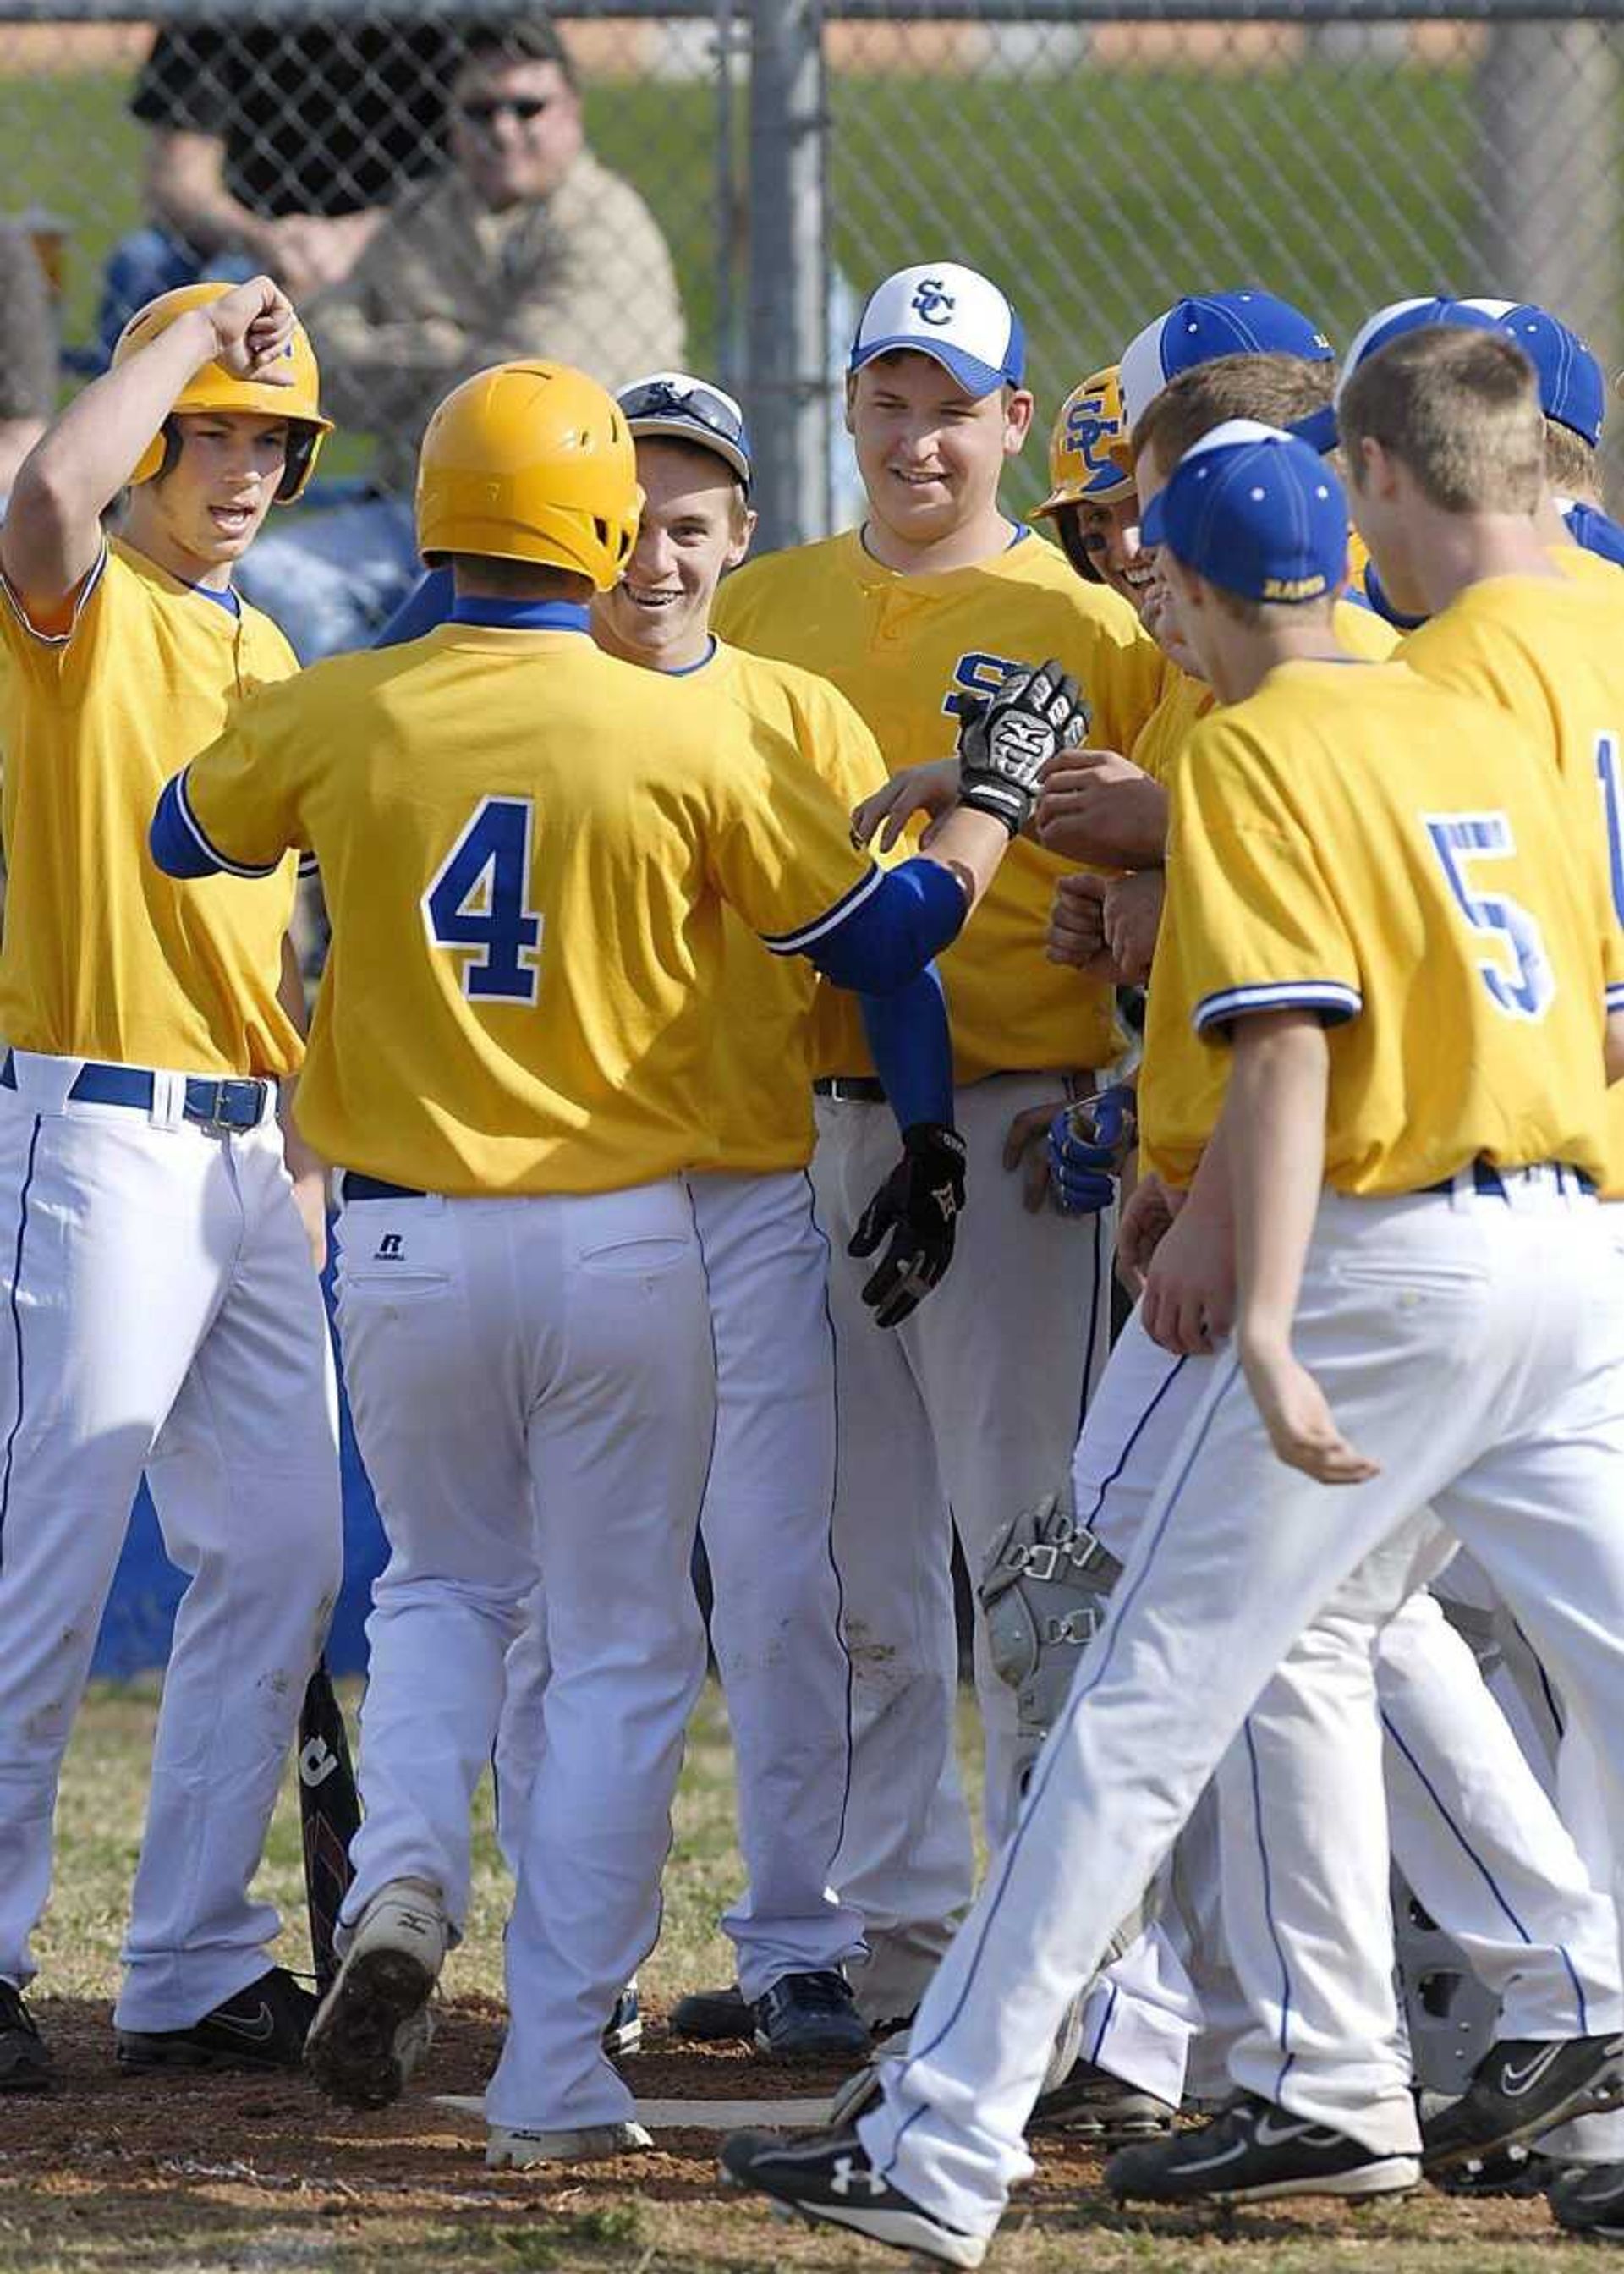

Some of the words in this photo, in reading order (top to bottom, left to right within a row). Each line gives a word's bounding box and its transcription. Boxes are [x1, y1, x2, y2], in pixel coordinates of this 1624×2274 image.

[911, 278, 955, 326] SC
[420, 793, 546, 1007] 4
[1418, 810, 1555, 1025] 5
